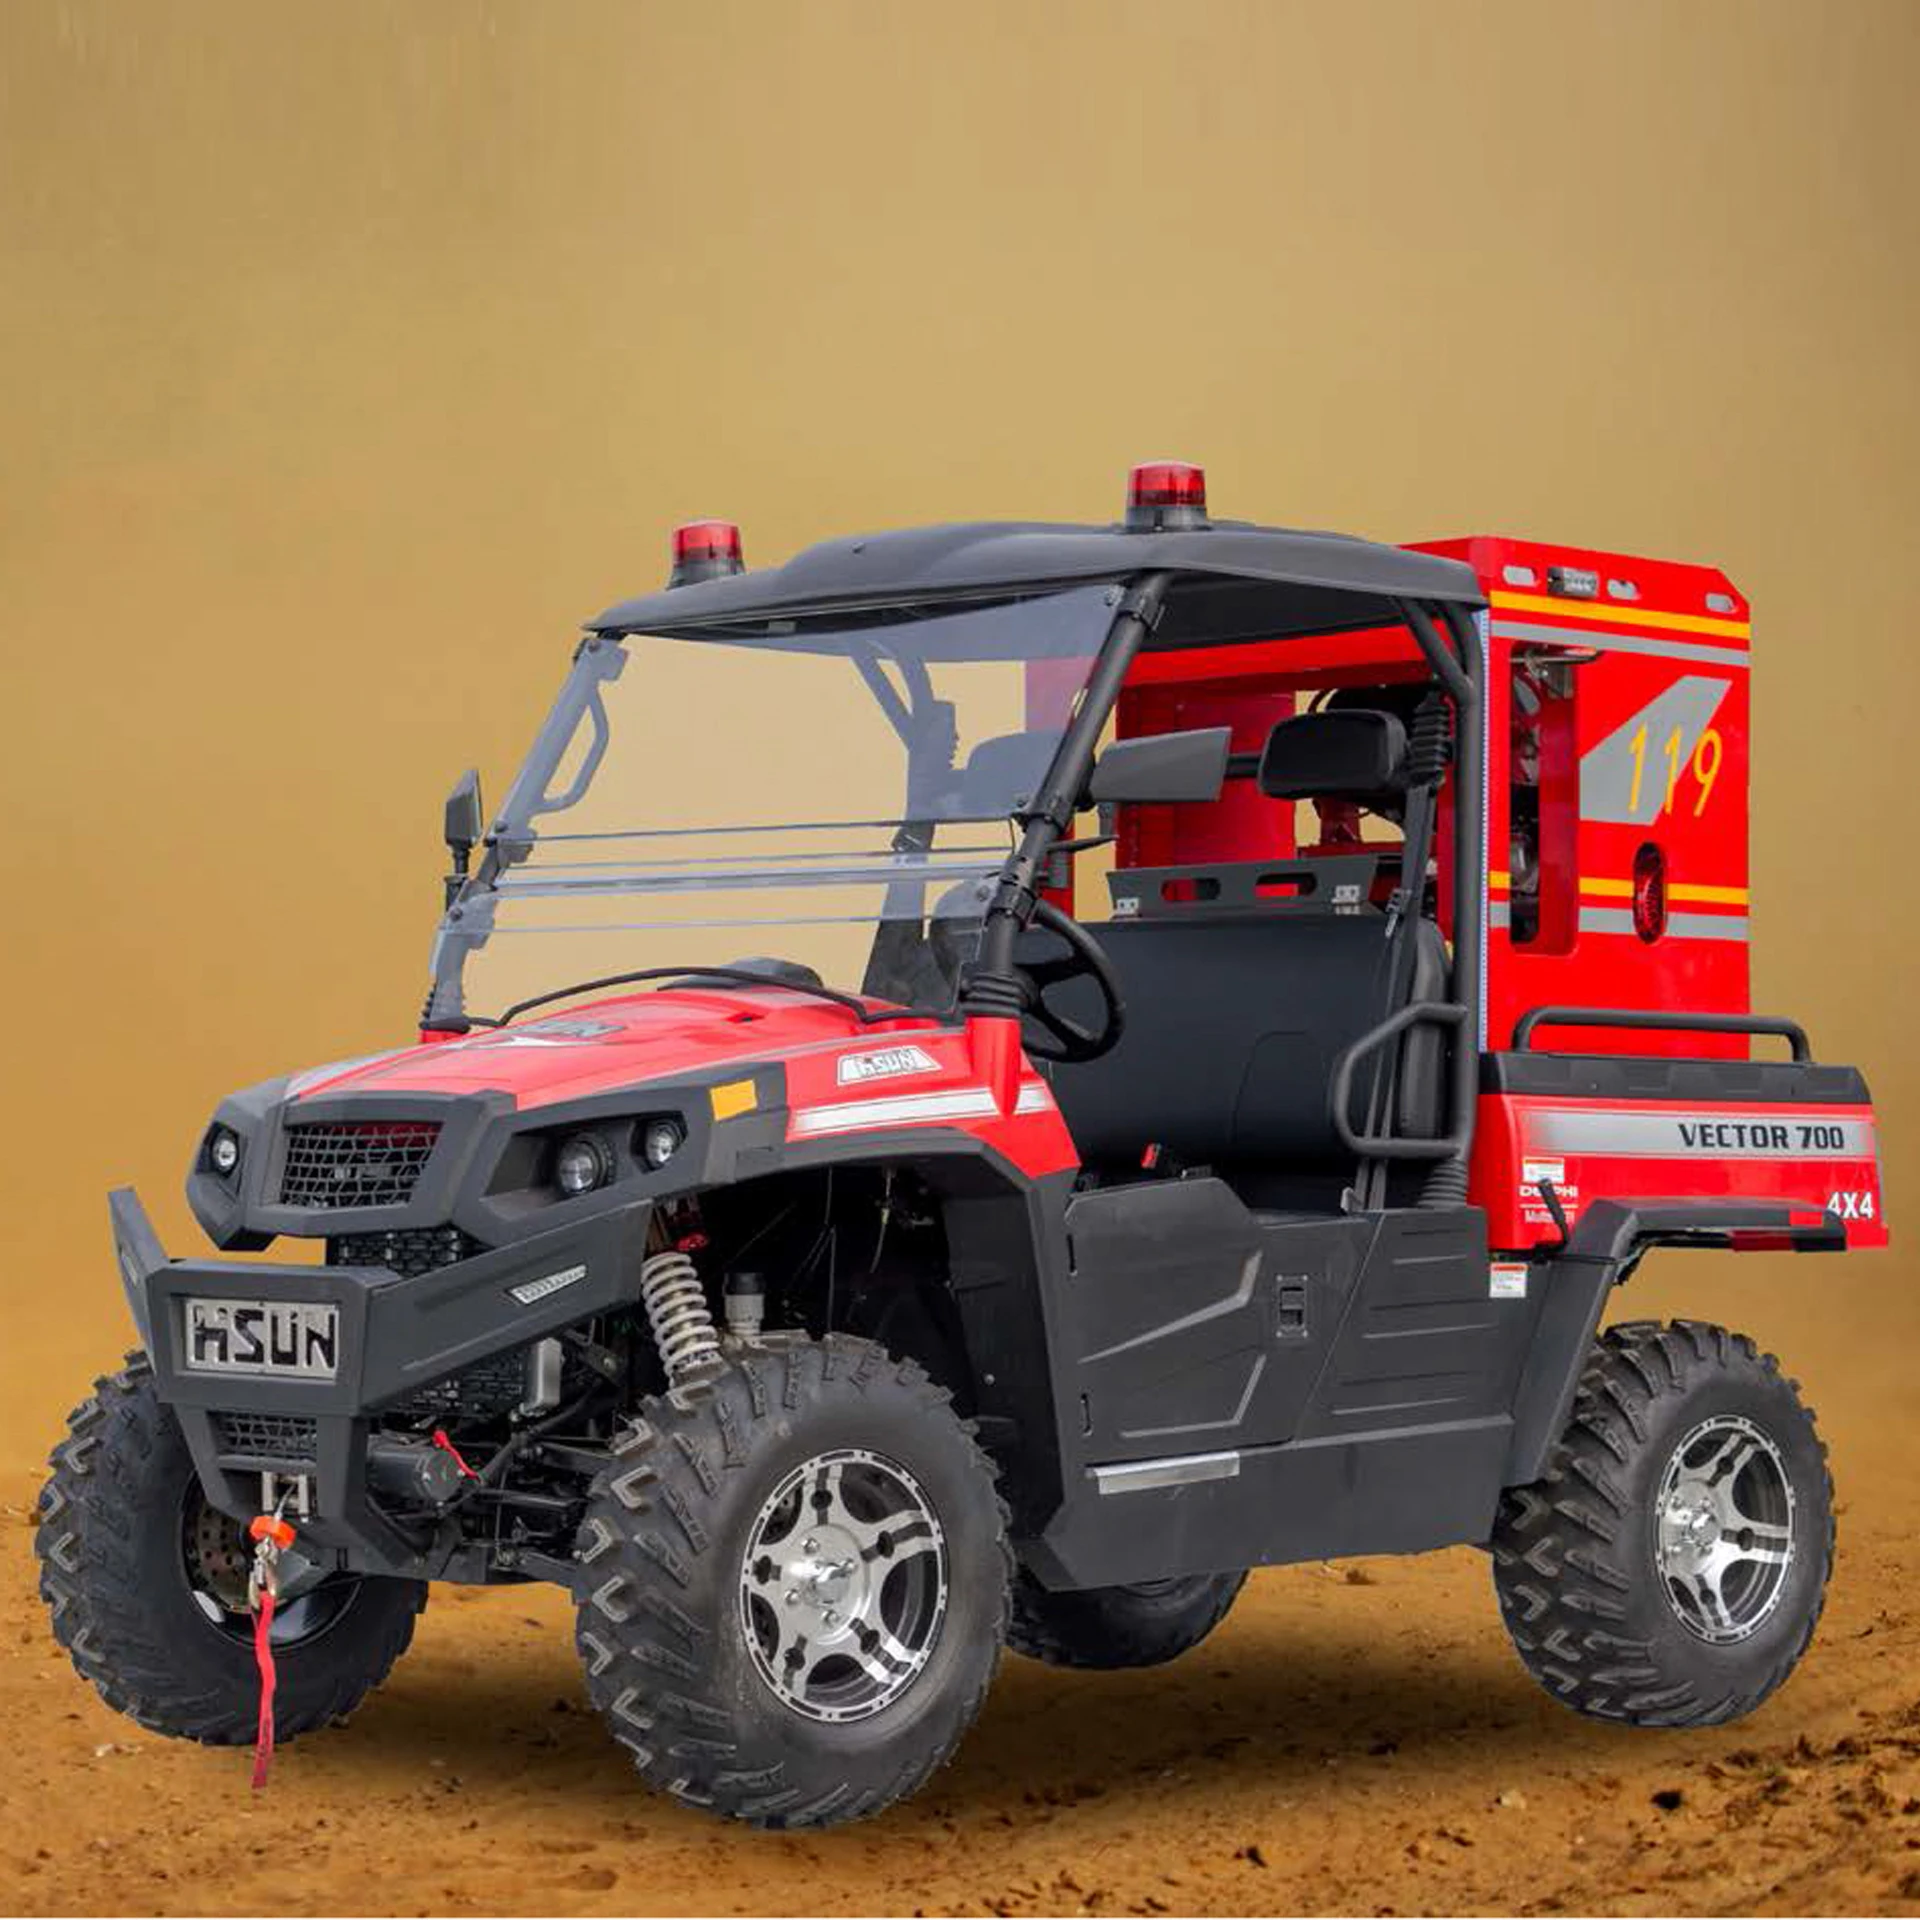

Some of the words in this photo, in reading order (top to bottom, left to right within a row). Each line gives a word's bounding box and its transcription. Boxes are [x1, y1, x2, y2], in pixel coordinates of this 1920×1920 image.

[1628, 724, 1722, 817] 119
[1679, 1123, 1789, 1150] VECTOR
[1796, 1126, 1844, 1149] 700
[1519, 1185, 1578, 1197] DEPHI
[1827, 1192, 1874, 1220] 4X4
[194, 1306, 335, 1369] HSUN
